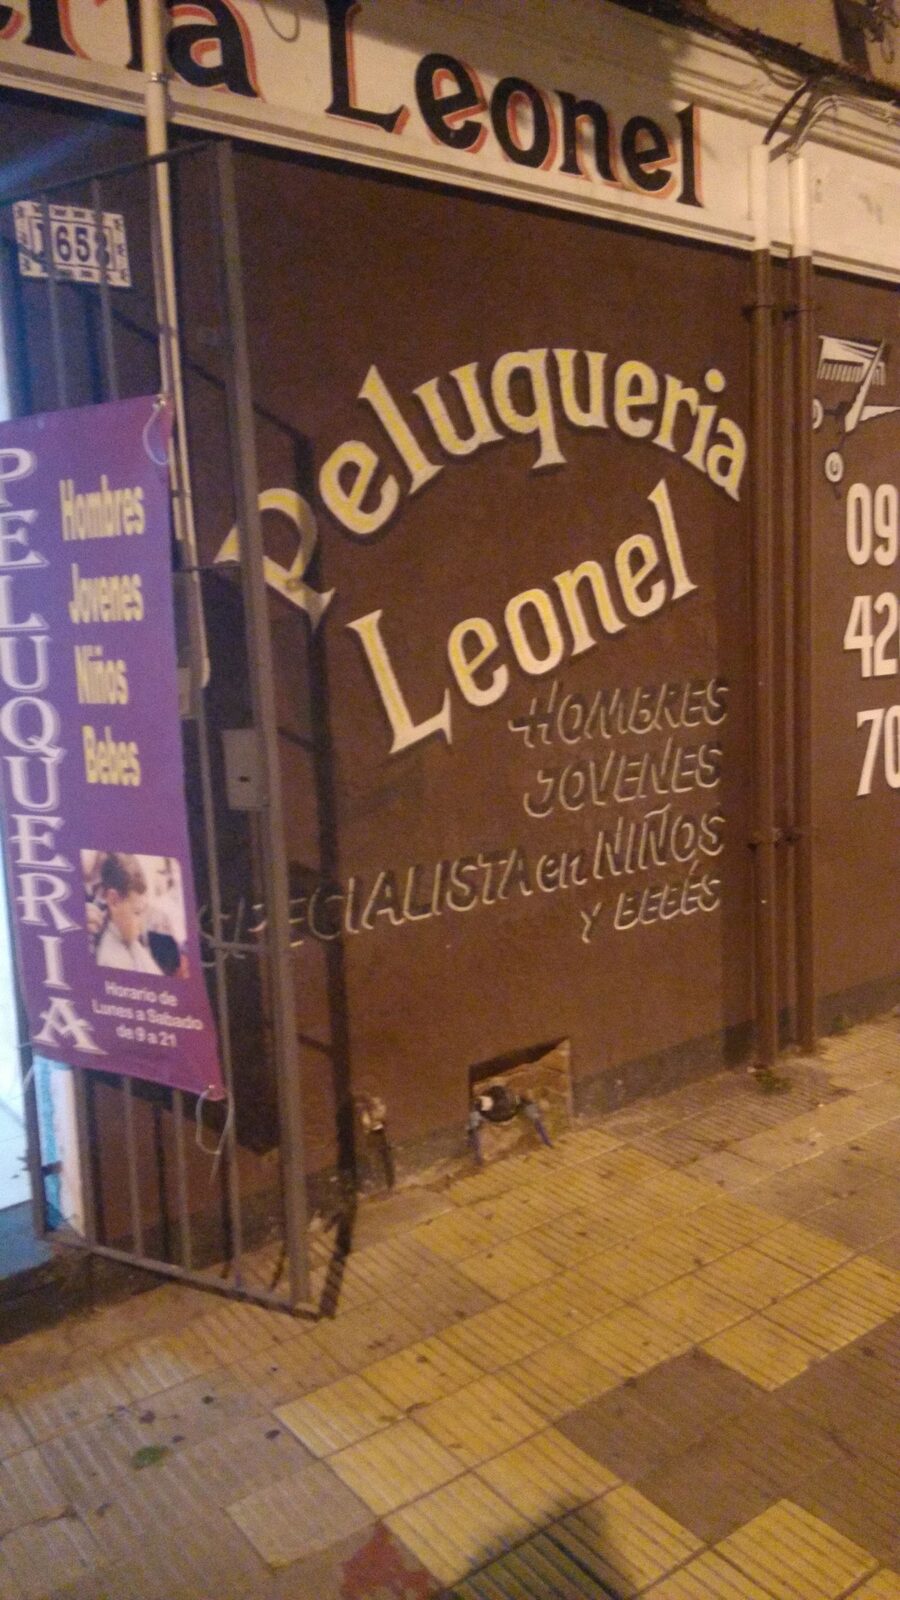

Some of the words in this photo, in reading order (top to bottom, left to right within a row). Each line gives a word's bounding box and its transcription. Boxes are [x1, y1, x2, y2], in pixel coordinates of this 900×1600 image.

[323, 0, 705, 208] Leonel
[59, 474, 146, 541] Hombres
[213, 347, 748, 632] Peluqueria
[69, 562, 144, 624] Jovenes
[346, 478, 699, 755] Leonel
[74, 644, 129, 705] Niños
[508, 679, 729, 748] HOMBRES
[0, 447, 108, 1056] PELUQUERIA
[81, 725, 142, 787] Bebes
[523, 737, 723, 818] JOVENES
[593, 803, 726, 879] NIÑOS
[92, 999, 134, 1019] Lunes
[135, 1010, 146, 1021] a
[105, 980, 157, 1003] Horario
[158, 991, 178, 1007] de
[116, 1025, 134, 1040] de
[135, 1027, 146, 1041] 9
[147, 1033, 158, 1044] a
[159, 1031, 177, 1048] 21
